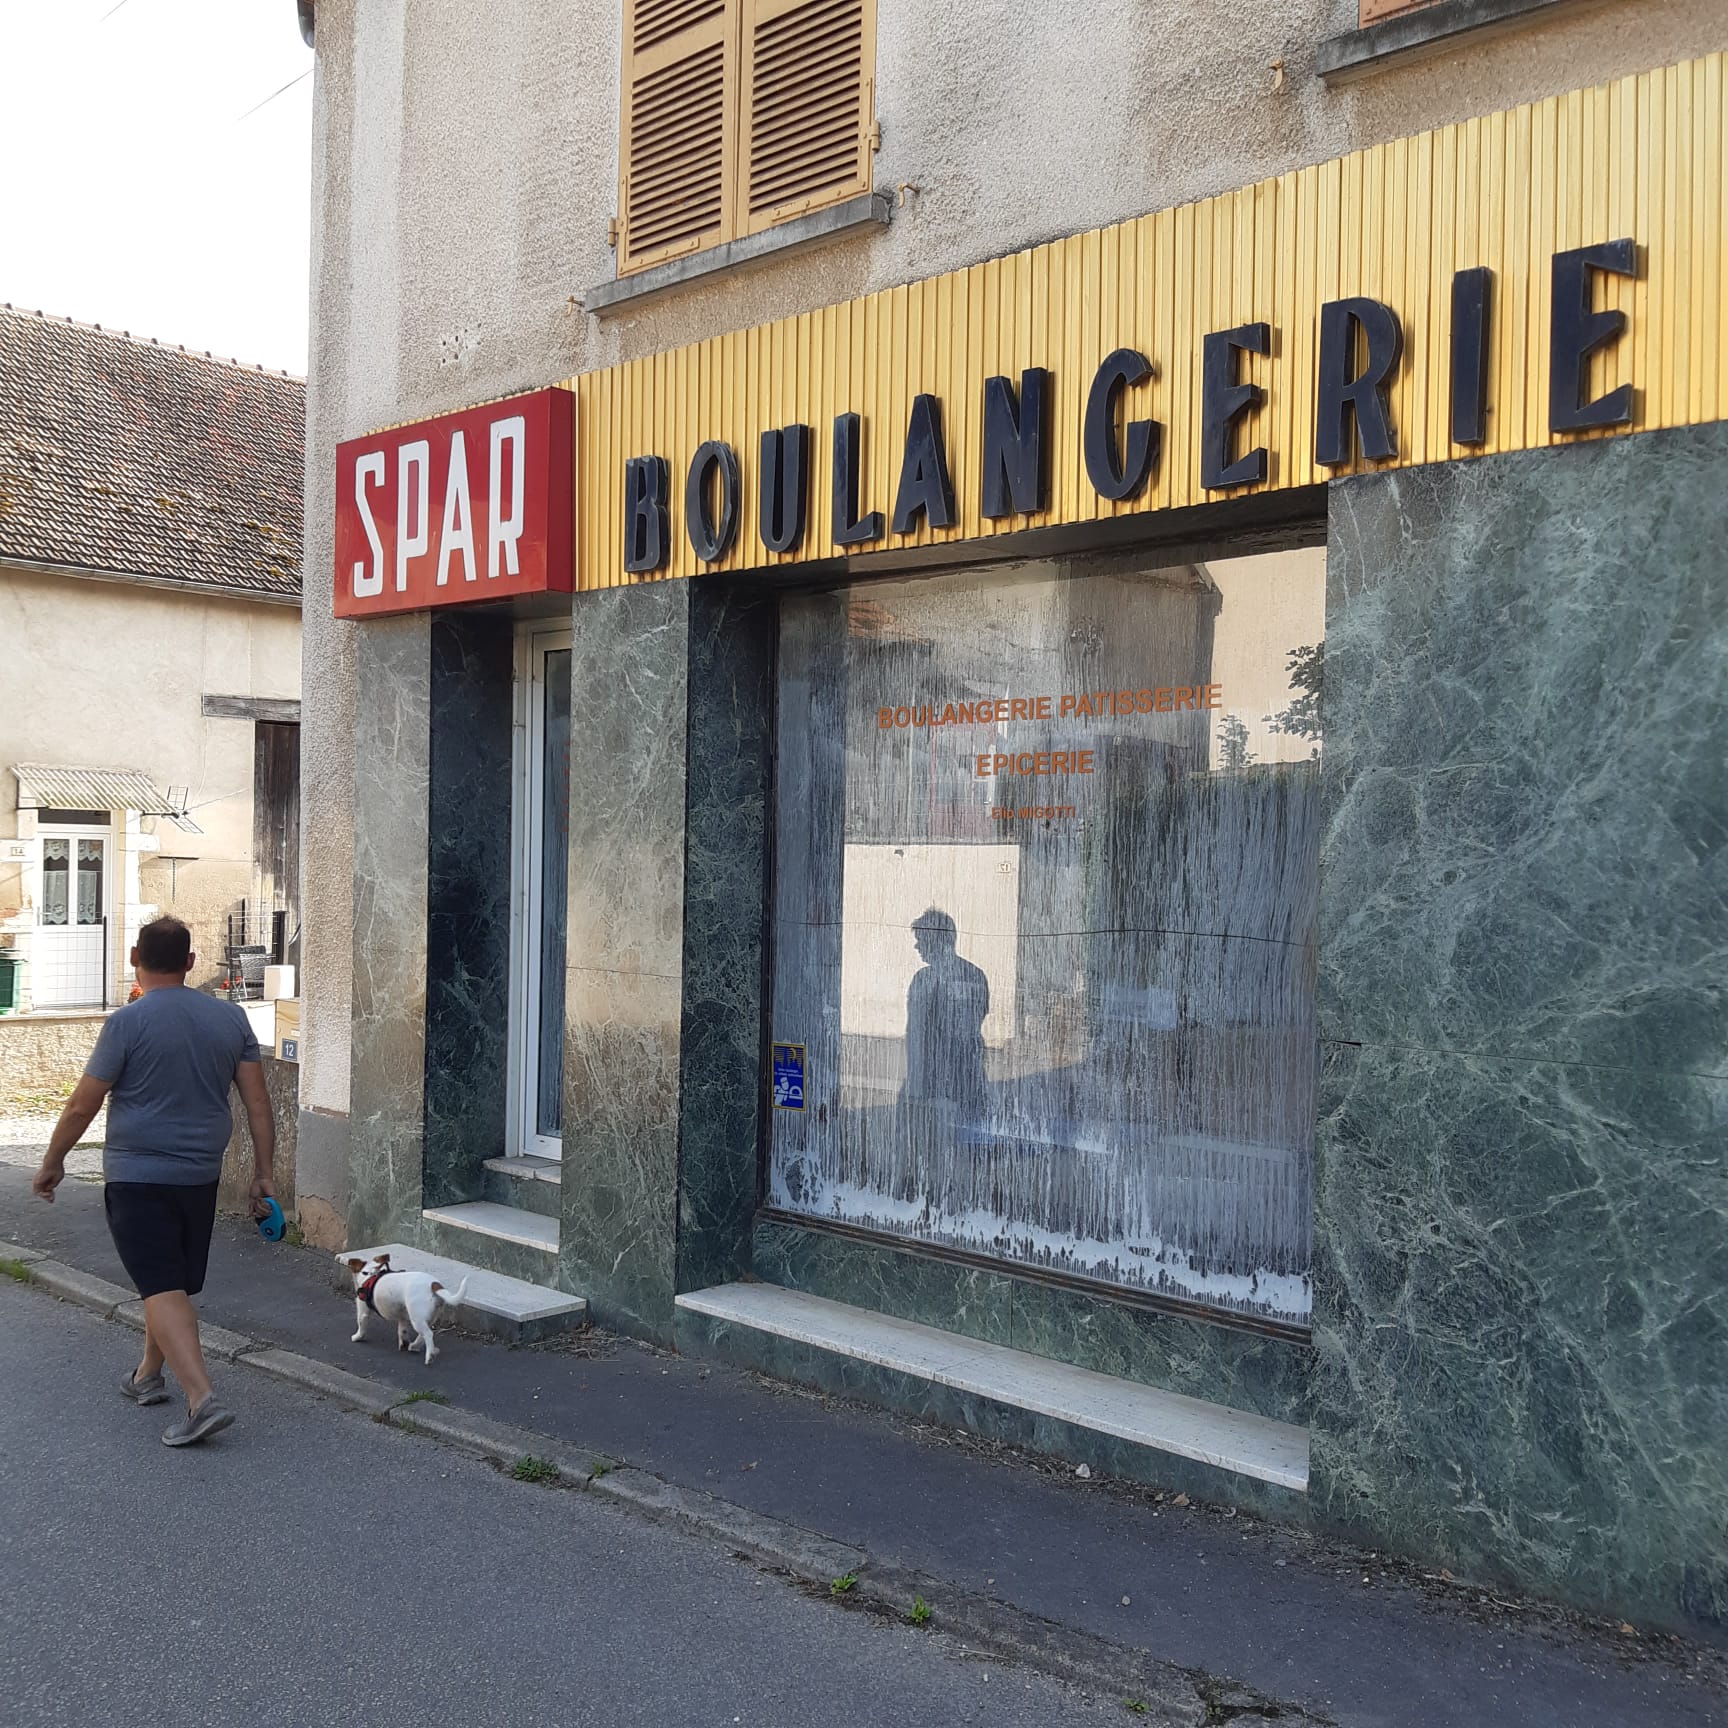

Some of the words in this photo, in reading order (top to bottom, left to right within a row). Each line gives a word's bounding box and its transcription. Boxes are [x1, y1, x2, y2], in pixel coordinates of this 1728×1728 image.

[623, 237, 1638, 574] BOULANGERIE
[353, 414, 526, 598] SPAR
[877, 696, 1052, 729] BOULANGERIE
[1059, 683, 1223, 719] PATISSERIE
[976, 750, 1095, 777] EPICERIE
[1018, 805, 1076, 819] MIGOTTI
[285, 1043, 294, 1057] 12
